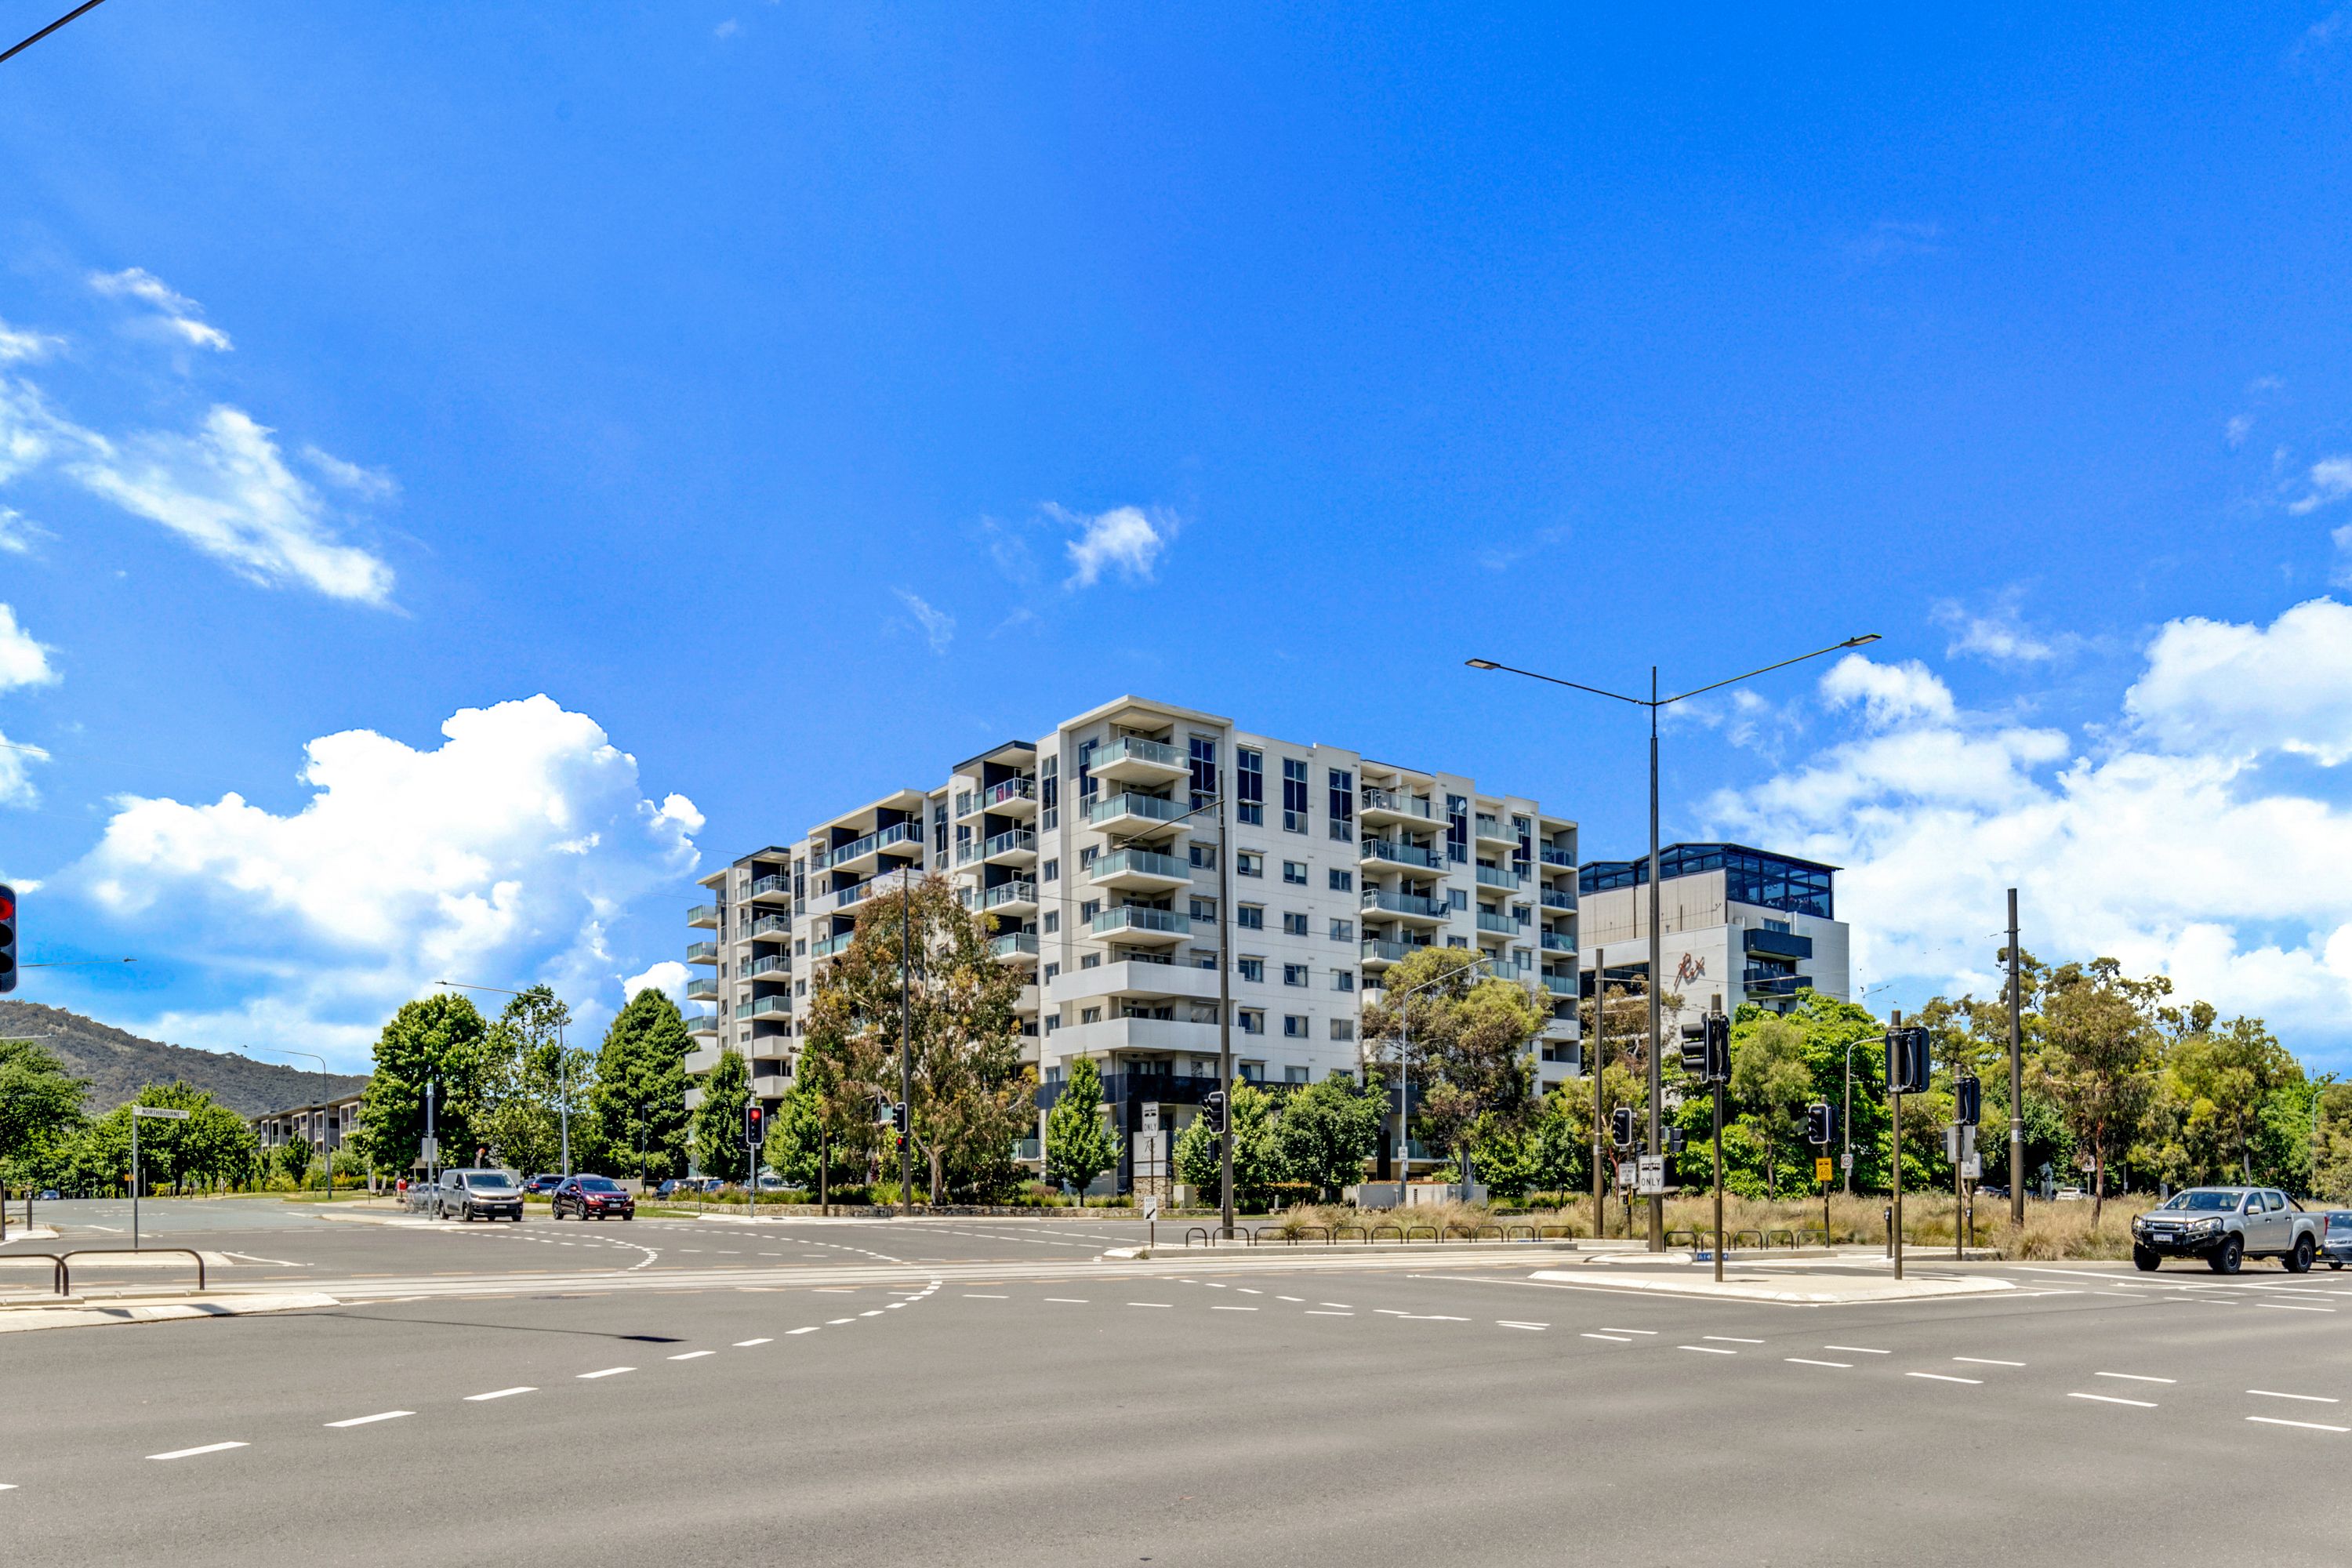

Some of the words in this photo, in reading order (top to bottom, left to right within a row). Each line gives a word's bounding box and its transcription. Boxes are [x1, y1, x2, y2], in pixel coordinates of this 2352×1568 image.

[142, 1109, 180, 1118] NORTHBOURNE
[1144, 1123, 1157, 1132] ONLY
[1641, 1178, 1661, 1186] ONLY
